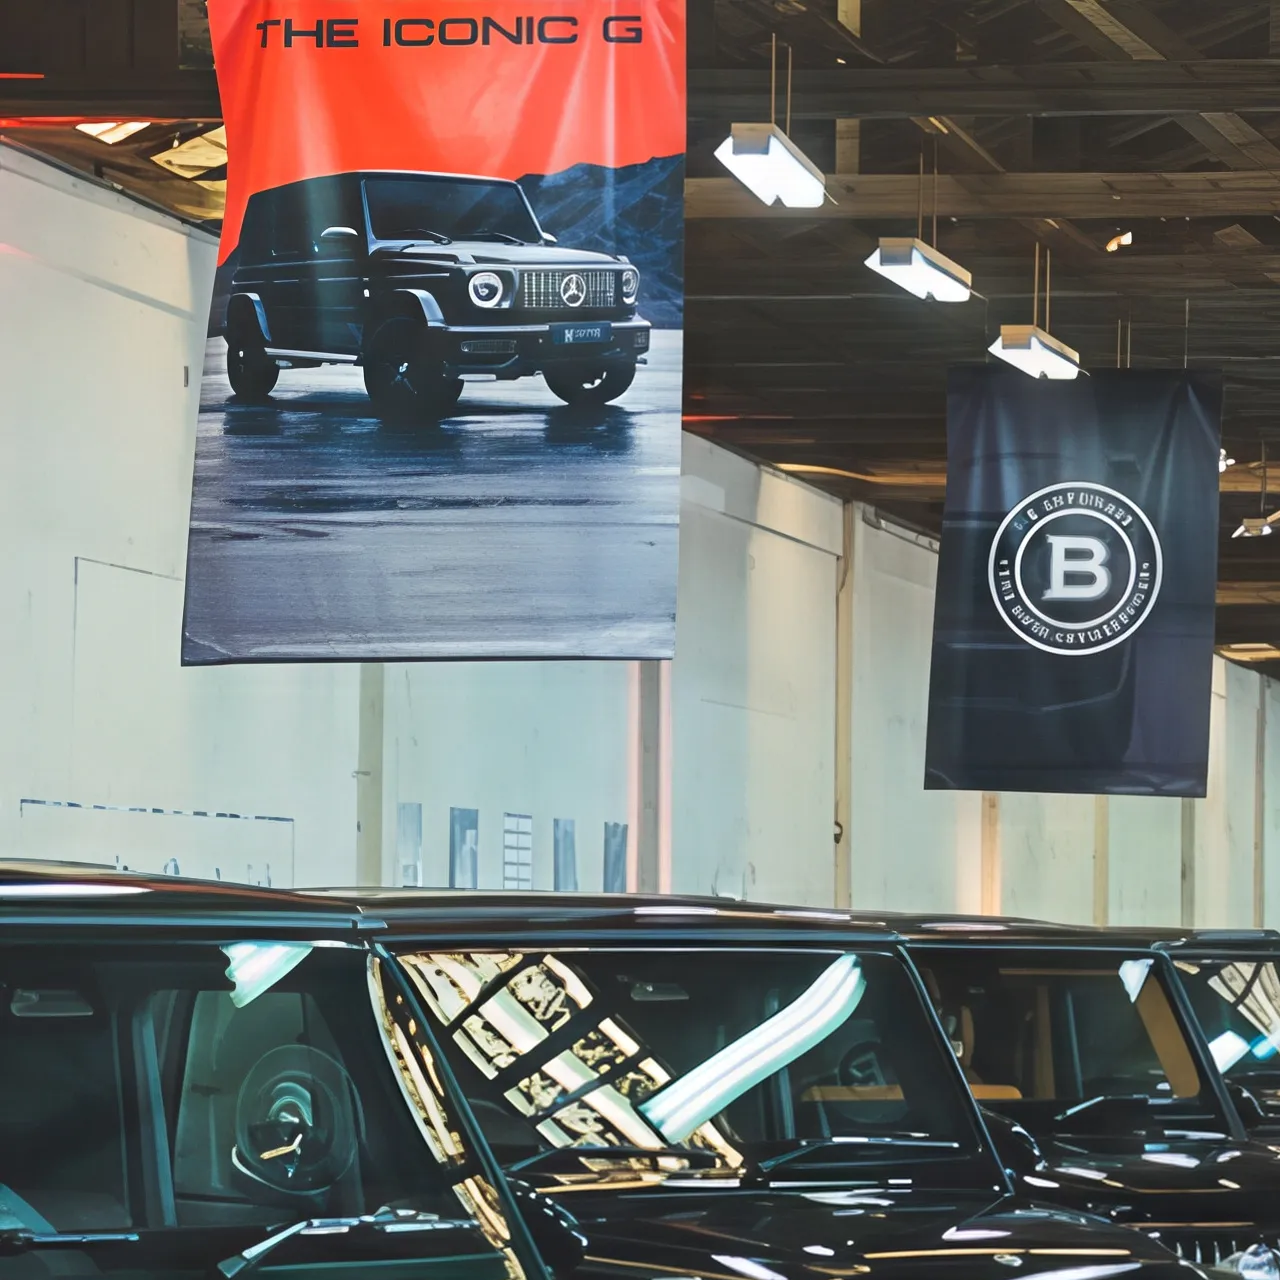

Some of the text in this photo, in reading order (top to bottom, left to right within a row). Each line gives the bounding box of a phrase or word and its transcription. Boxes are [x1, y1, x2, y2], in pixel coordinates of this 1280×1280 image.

[257, 15, 643, 48] THE ICONIC G
[1041, 534, 1112, 601] B
